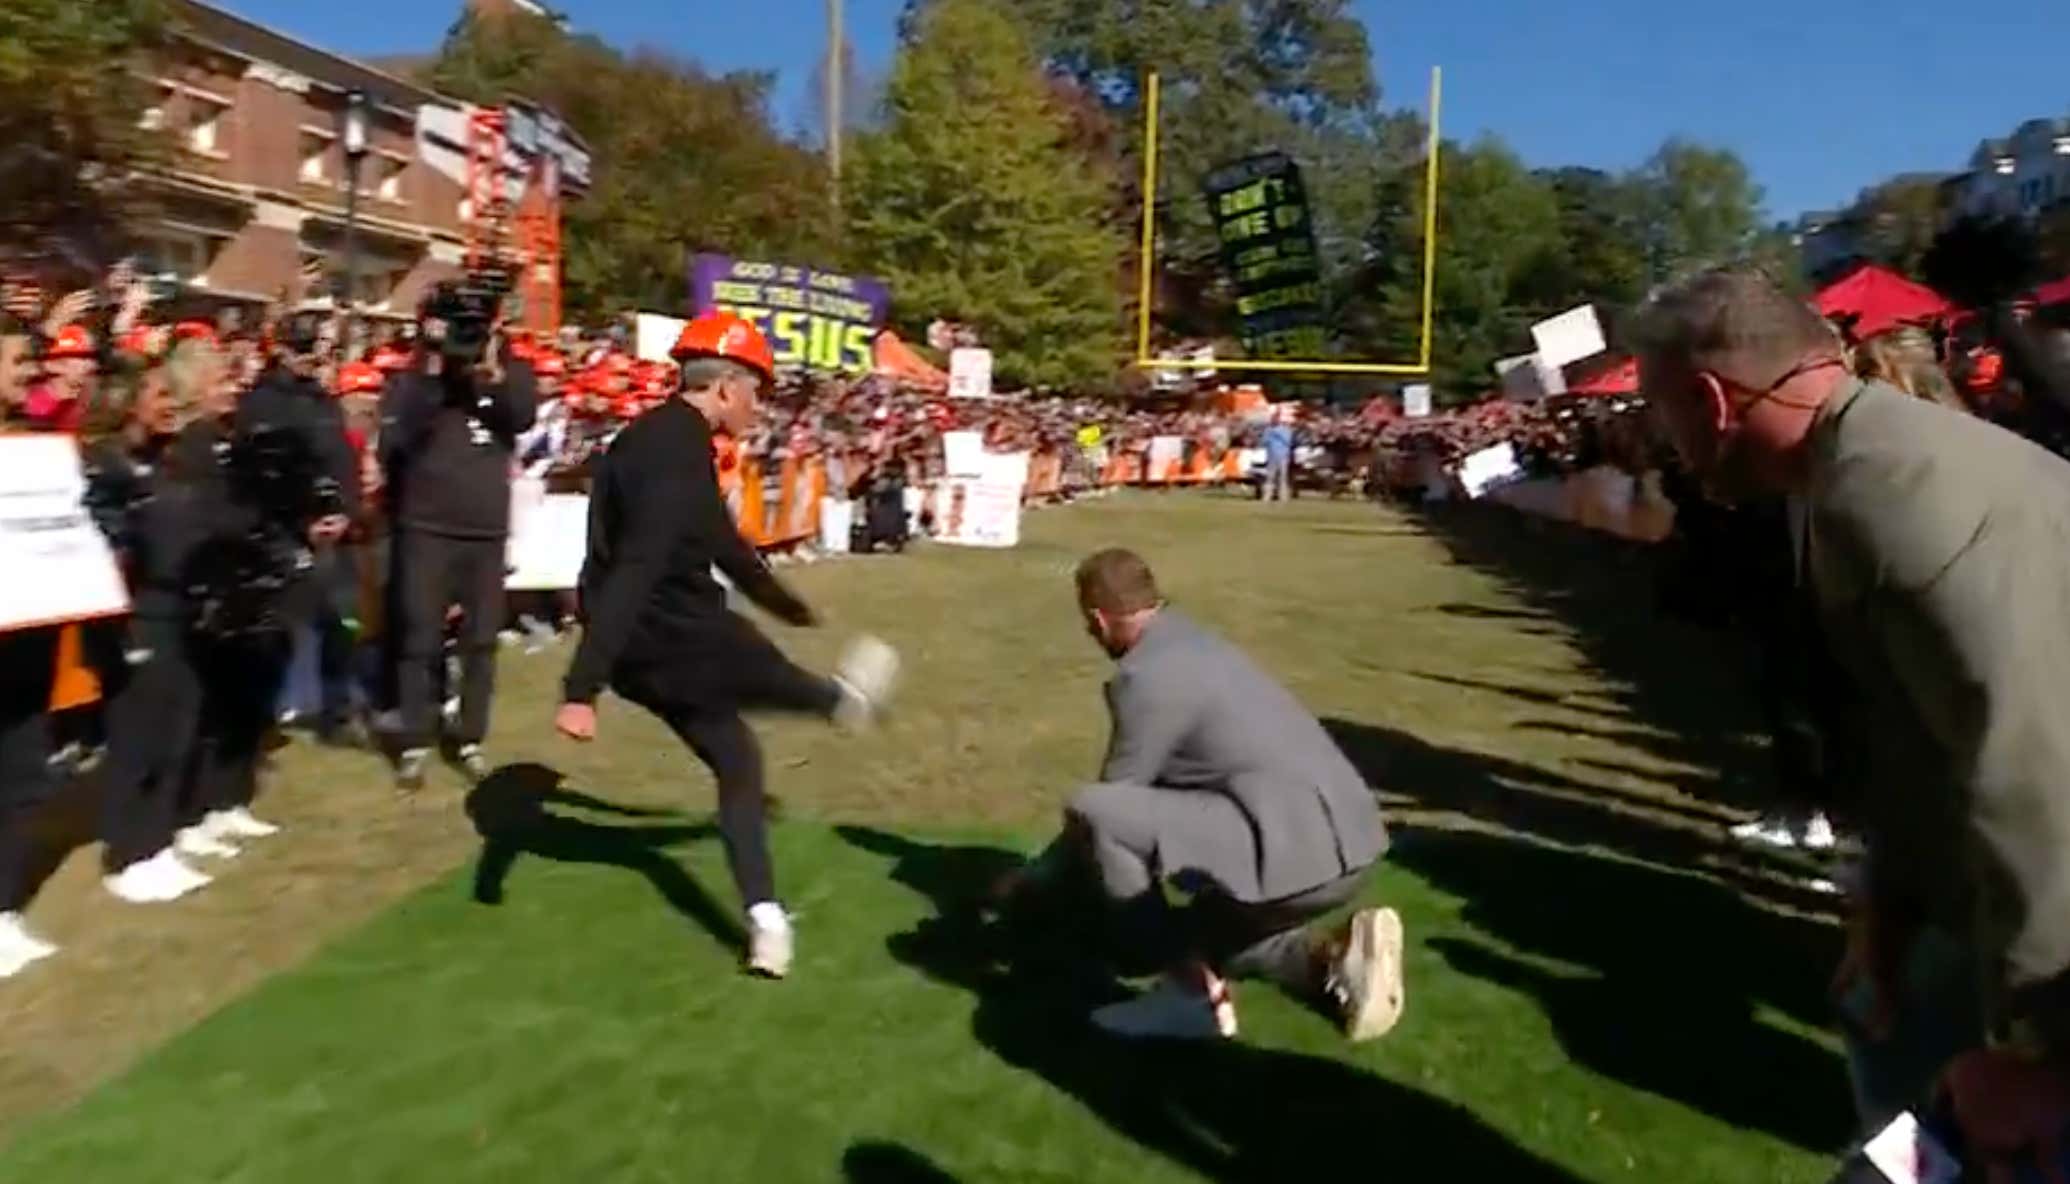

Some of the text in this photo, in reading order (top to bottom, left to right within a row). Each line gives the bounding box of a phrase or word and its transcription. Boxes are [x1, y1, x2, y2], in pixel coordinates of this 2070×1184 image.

[732, 262, 854, 292] GOD IS LOVE
